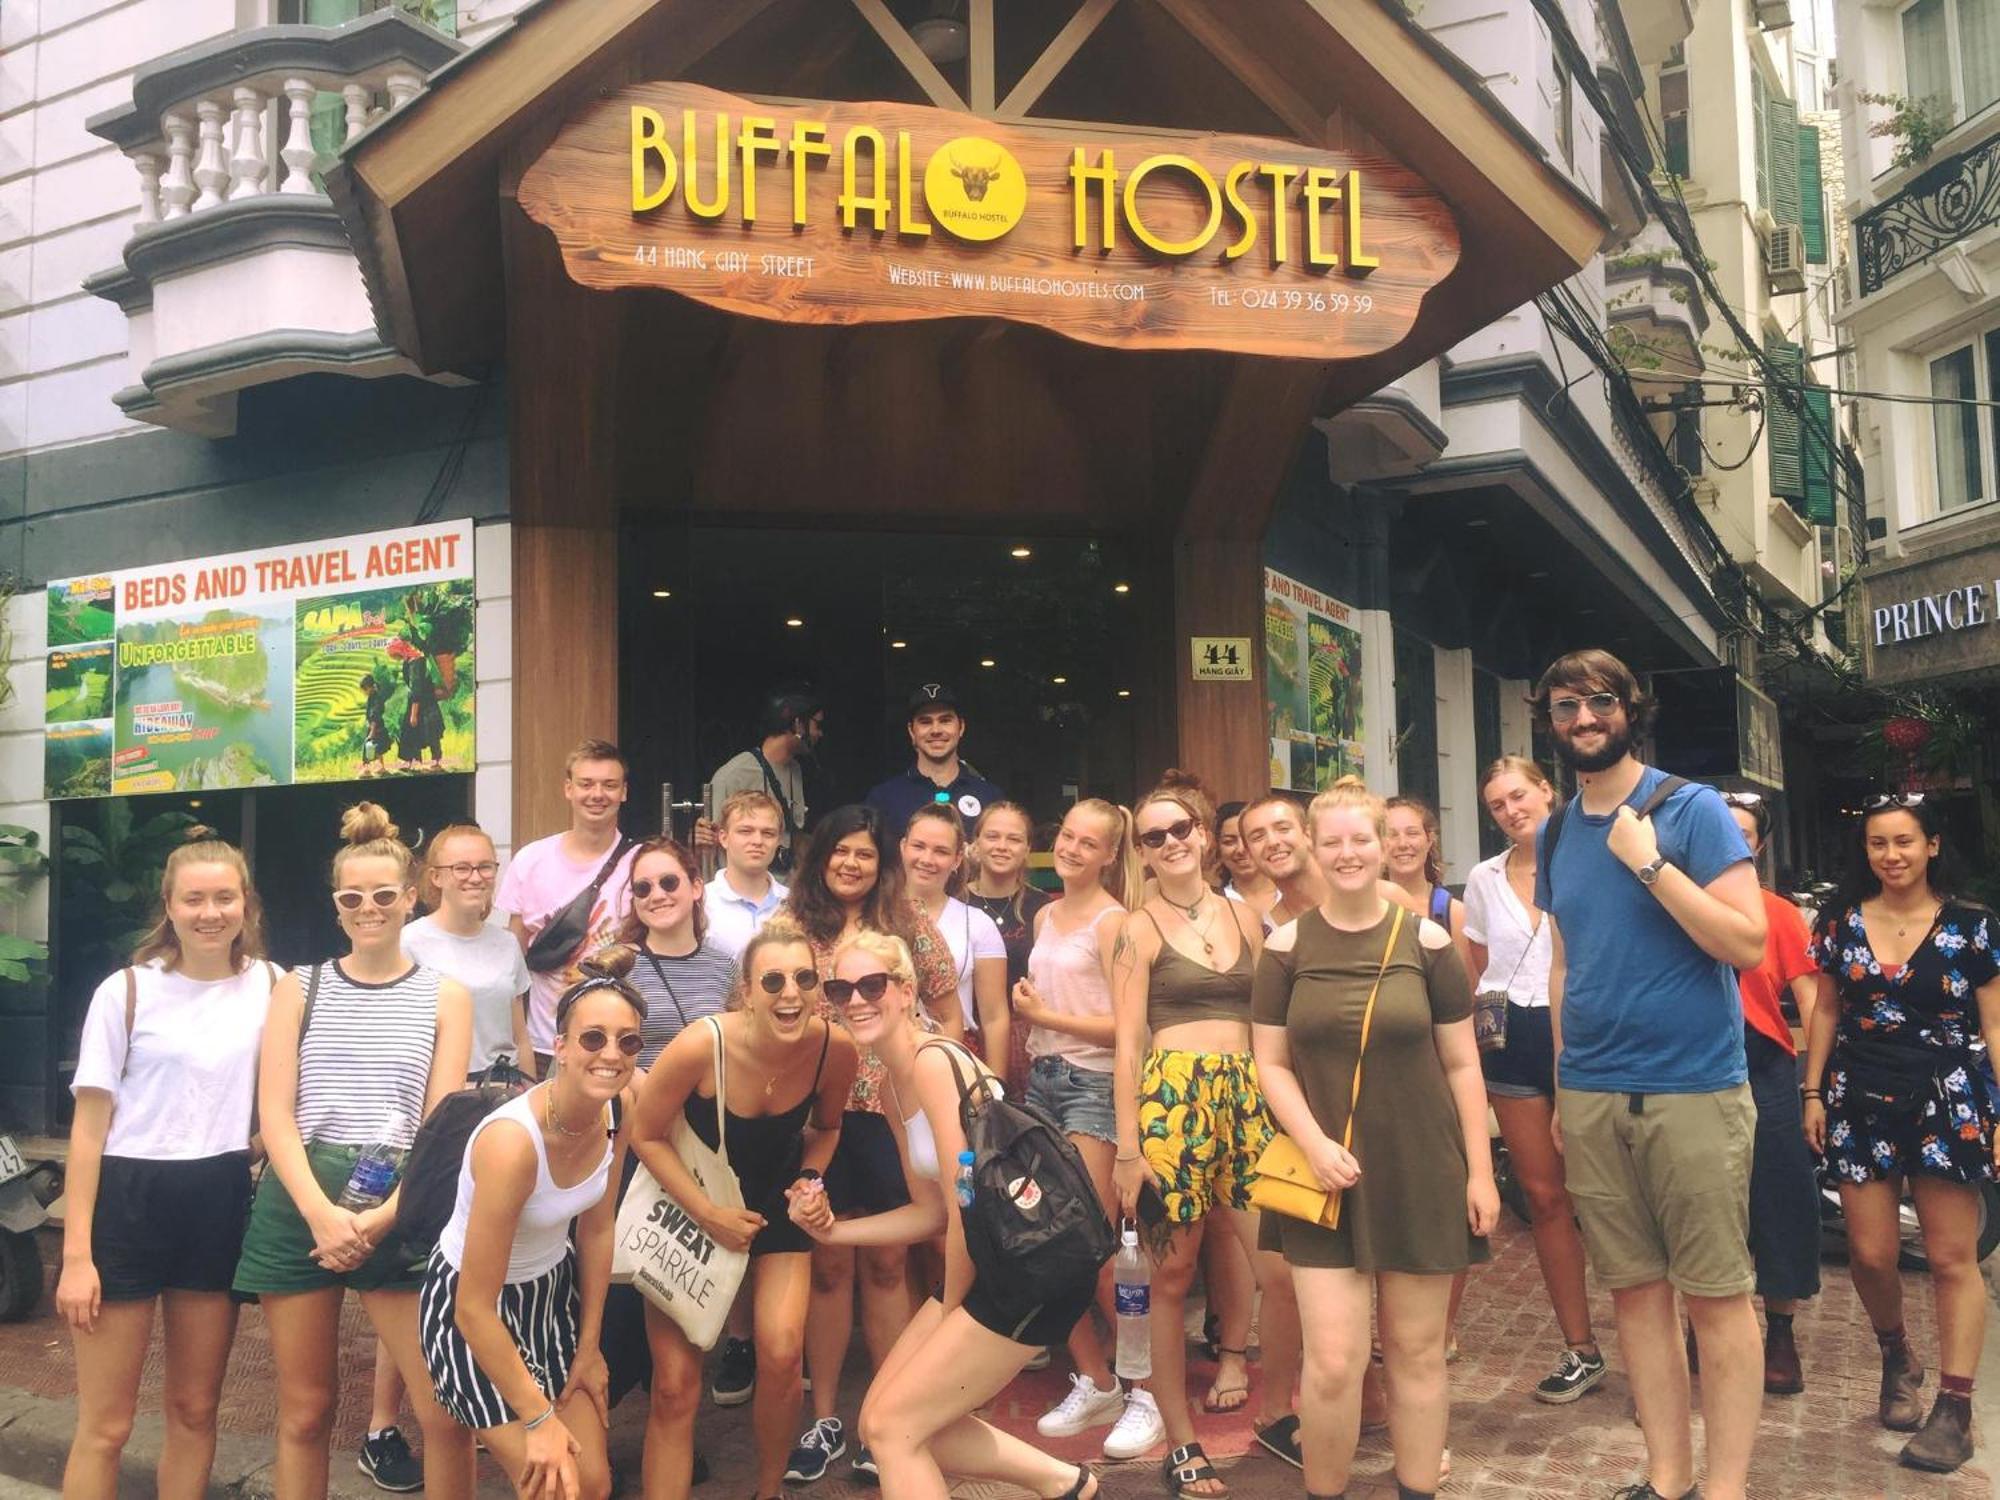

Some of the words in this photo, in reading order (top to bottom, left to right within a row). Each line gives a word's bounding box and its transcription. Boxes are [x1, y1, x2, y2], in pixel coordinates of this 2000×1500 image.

[943, 208, 977, 221] BUFFALO
[979, 212, 1009, 224] HOSTEL
[1069, 147, 1381, 269] HOSTEL
[633, 245, 657, 267] 44
[664, 246, 706, 271] HANG
[715, 250, 750, 274] GIAY
[761, 255, 816, 278] STREET
[1241, 287, 1277, 310] 024
[1282, 290, 1302, 310] 39
[1305, 292, 1326, 312] 36
[1330, 293, 1349, 313] 59
[1353, 295, 1373, 314] 59
[123, 571, 188, 611] BEDS
[194, 566, 247, 602] AND
[254, 549, 357, 594] TRAVEL
[365, 534, 461, 580] AGENT
[1272, 575, 1290, 597] AND
[1292, 584, 1323, 613] TRAVEL
[1326, 599, 1350, 624] AGENT
[1873, 584, 1985, 646] PRINCE
[119, 632, 256, 667] UNFORGETTABLE
[1203, 643, 1240, 665] 44
[646, 1199, 715, 1266] SWEAT
[629, 1226, 715, 1310] SPARKLE
